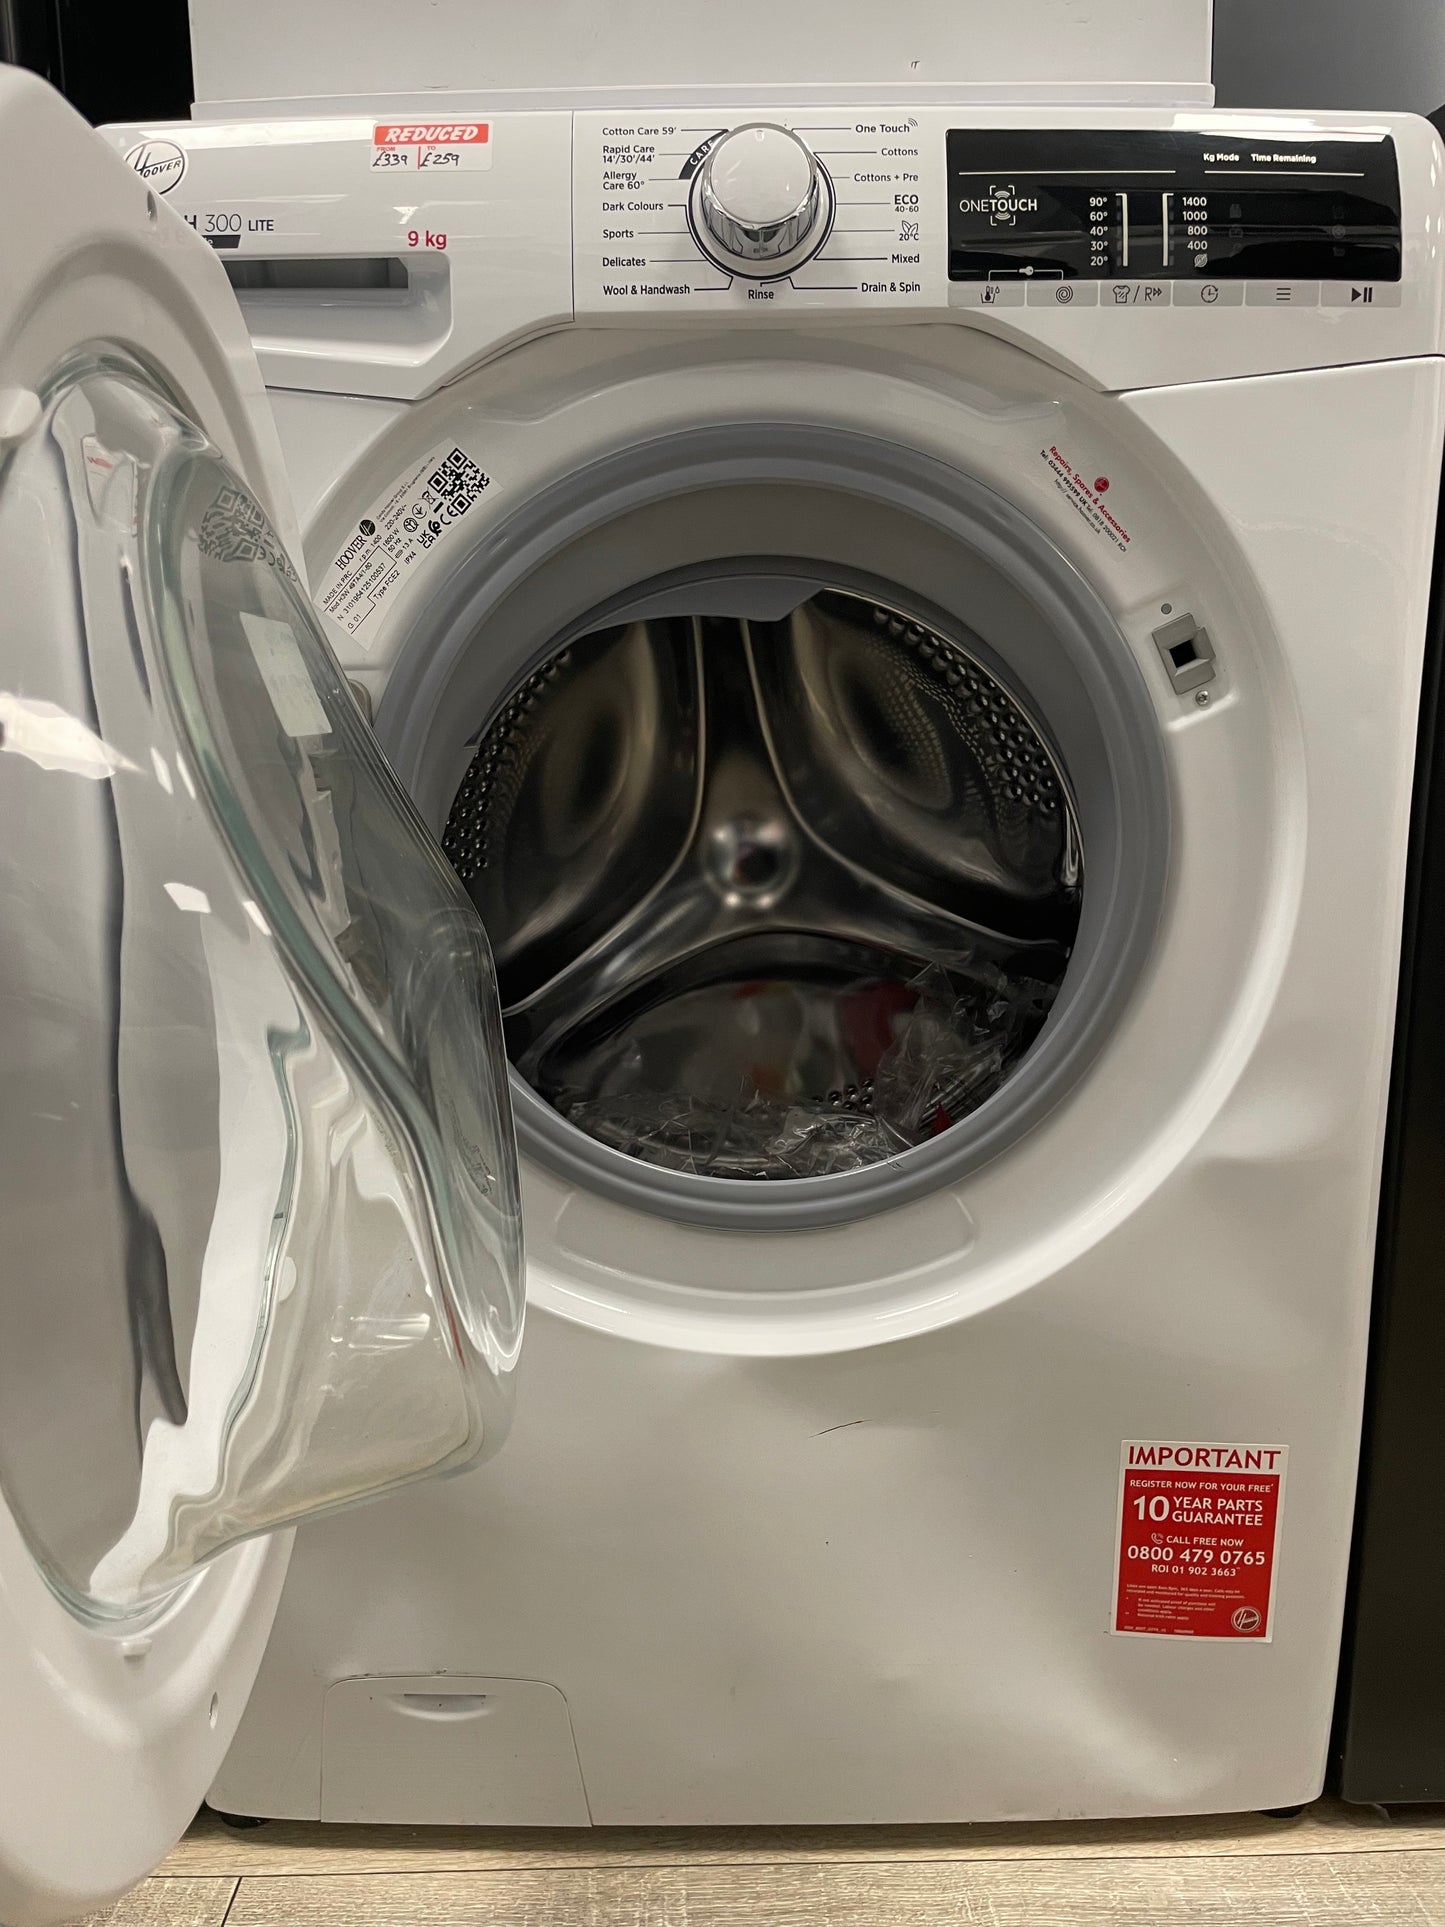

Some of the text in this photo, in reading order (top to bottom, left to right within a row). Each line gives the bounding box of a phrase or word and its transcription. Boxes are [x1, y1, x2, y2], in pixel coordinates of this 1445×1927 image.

[602, 126, 677, 136] Cotton Care 59'
[855, 123, 910, 133] One Touch
[384, 126, 479, 142] REDUCED
[602, 144, 655, 155] Rapid Care
[689, 138, 713, 165] CARE
[881, 147, 919, 156] Cottons
[372, 151, 408, 167] £339
[419, 152, 460, 167] £259
[602, 154, 655, 165] 14'/30'/44'
[1203, 153, 1240, 162] Kg Mode
[1251, 153, 1317, 164] Time Remaining
[602, 171, 637, 181] Allergy
[854, 173, 892, 182] Cottons
[903, 173, 919, 182] Pre
[602, 181, 625, 191] Care
[894, 194, 919, 205] ECO
[1089, 197, 1108, 207] 90°
[1182, 196, 1207, 206] 1400
[602, 201, 664, 212] Dark Colours
[894, 205, 919, 213] 40-60
[959, 199, 1038, 213] ONETOUCH
[1089, 211, 1108, 221] 60°
[1182, 211, 1208, 221] 1000
[204, 213, 242, 233] 300
[248, 219, 274, 232] LITE
[602, 229, 634, 240] Sports
[1089, 226, 1109, 236] 40°
[1187, 225, 1208, 236] 800
[408, 230, 447, 250] 9 kg
[899, 233, 919, 241] 20°C
[1090, 241, 1109, 251] 30°
[1187, 240, 1208, 250] 400
[602, 256, 646, 267] Delicates
[891, 254, 920, 264] Mixed
[1090, 256, 1109, 266] 20°
[602, 283, 691, 296] Wool & Handwash
[861, 282, 921, 294] Drain & Spin
[748, 289, 774, 299] Rinse
[1048, 459, 1063, 477] 03444
[1062, 476, 1080, 496] 995599
[1078, 496, 1087, 505] UK
[1092, 512, 1104, 525] 0818
[1049, 446, 1071, 475] Repairs,
[1072, 473, 1092, 498] Spares
[1097, 504, 1130, 542] Accessories
[392, 527, 399, 535] W
[416, 529, 429, 543] UK
[370, 534, 382, 547] 1400
[387, 537, 401, 552] 50 Hz
[334, 534, 367, 570] HOOVER
[403, 551, 416, 564] IPX4
[322, 570, 352, 603] MADE IN PRC
[373, 569, 400, 598] Type FCE2
[1128, 1446, 1281, 1470] IMPORTANT
[1130, 1480, 1172, 1488] REGISTER
[1175, 1481, 1197, 1489] NOW
[1200, 1482, 1218, 1490] FOR
[1220, 1483, 1246, 1492] YOUR
[1133, 1495, 1263, 1522] 10 YEAR PARTS
[1172, 1511, 1263, 1526] GUARANTEE
[1166, 1535, 1244, 1547] CALL FREE NOW
[1127, 1545, 1265, 1565] 0800 479 0765
[1151, 1564, 1169, 1573] ROI
[1172, 1565, 1184, 1574] 01
[1188, 1566, 1208, 1575] 902
